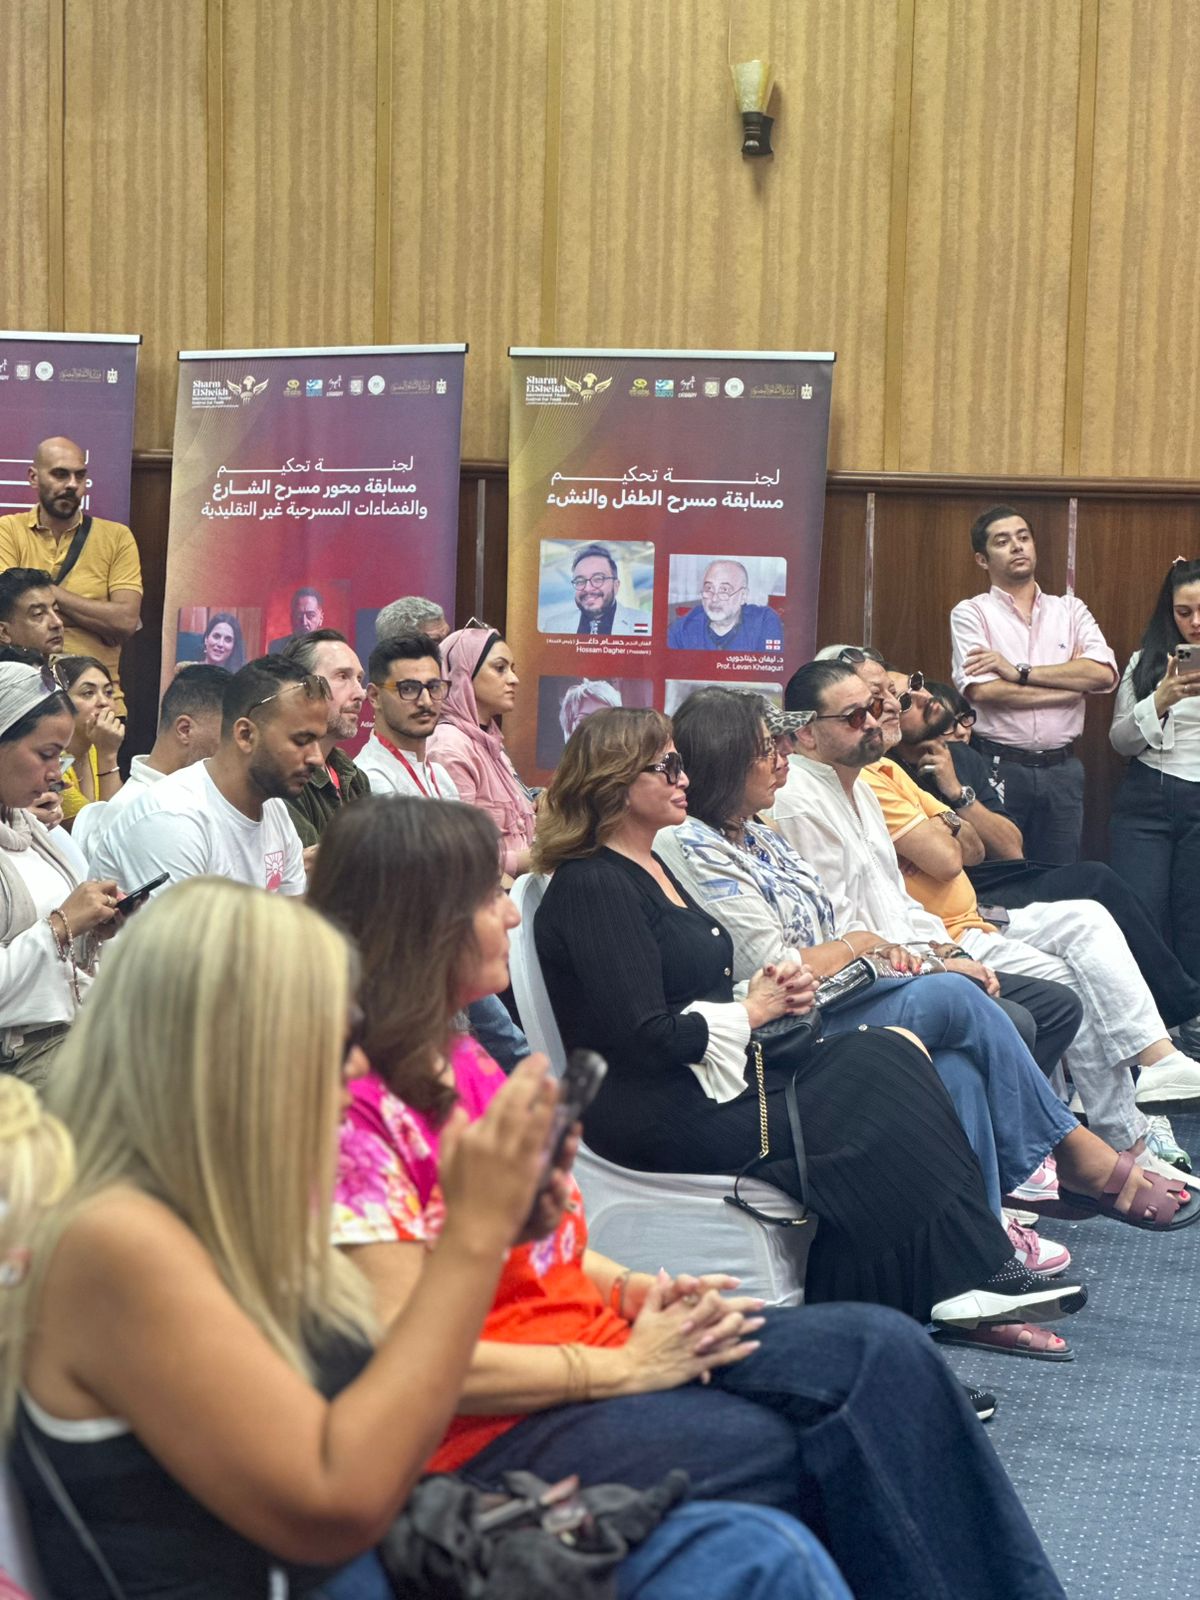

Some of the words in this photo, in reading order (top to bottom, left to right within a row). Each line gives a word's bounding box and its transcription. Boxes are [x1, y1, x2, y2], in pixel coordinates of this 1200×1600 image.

[193, 380, 221, 388] Sharm
[526, 376, 557, 384] Sharm
[213, 480, 271, 500] الشارع
[274, 484, 320, 500] مسرح
[323, 484, 360, 498] محور
[364, 478, 417, 494] مسابقة
[547, 488, 607, 509] والنشء
[612, 489, 662, 508] الطفل
[667, 495, 717, 513] مسرح
[722, 490, 783, 511] مسابقة
[201, 501, 256, 520] التقليدية
[259, 505, 282, 520] غير
[286, 501, 350, 519] المسرحية
[354, 500, 428, 519] والفضاءات
[603, 647, 626, 655] Dagher
[733, 663, 752, 671] Levan
[752, 664, 784, 672] Khetaguri
